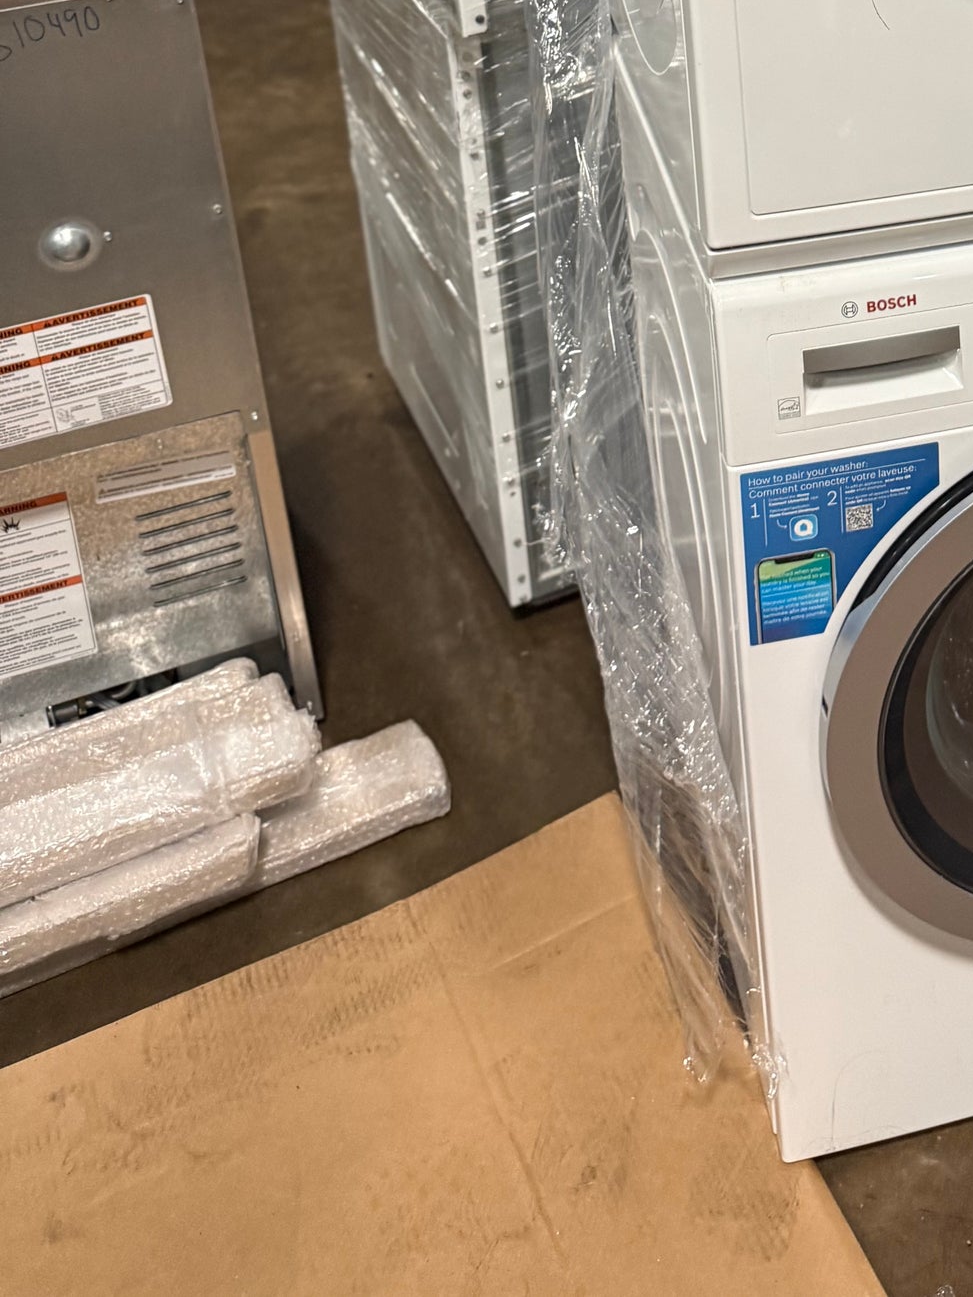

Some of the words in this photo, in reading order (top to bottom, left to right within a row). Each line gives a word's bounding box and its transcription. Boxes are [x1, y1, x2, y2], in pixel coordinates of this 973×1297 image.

[50, 299, 139, 326] AVERTISSEMENT
[866, 294, 917, 313] BOSCH
[59, 332, 145, 359] AVERTISSEMENT
[748, 477, 770, 487] How
[785, 470, 805, 482] pair
[806, 467, 828, 478] your
[830, 461, 869, 473] washer:
[748, 484, 798, 499] Comment
[800, 475, 849, 491] connecter
[851, 472, 876, 482] votre
[878, 465, 917, 478] laveuse:
[750, 502, 760, 519] 1
[826, 490, 838, 507] 2
